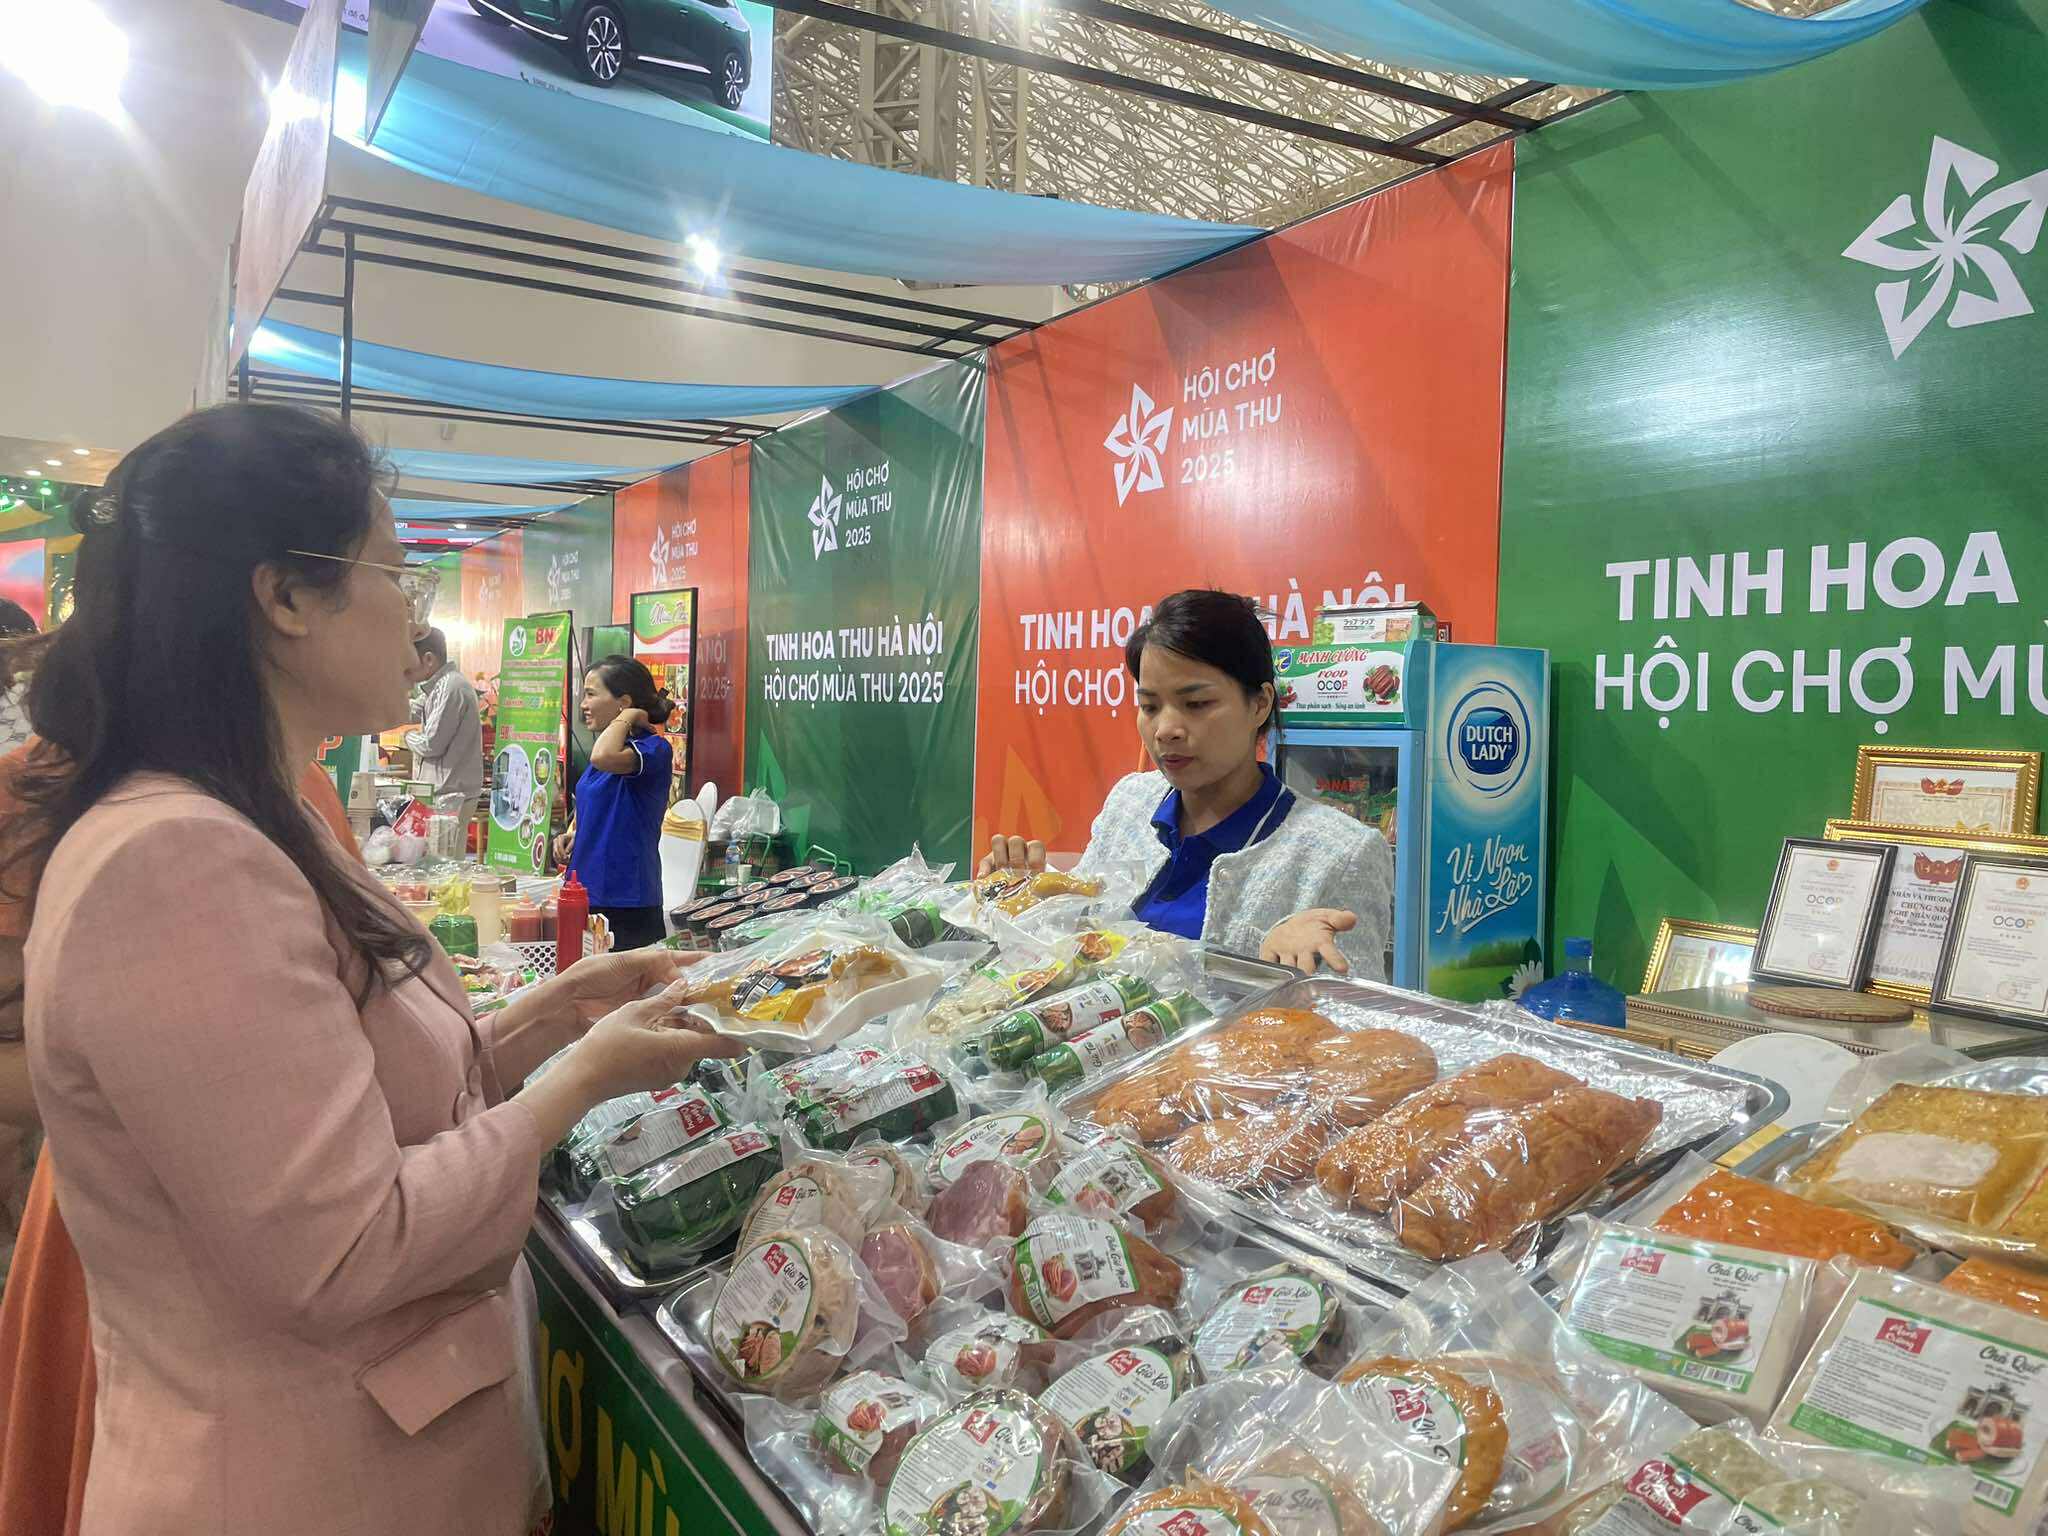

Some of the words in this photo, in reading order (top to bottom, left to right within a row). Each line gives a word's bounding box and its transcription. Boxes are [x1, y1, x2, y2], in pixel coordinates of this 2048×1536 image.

[1183, 366, 1219, 403] HỘI
[1225, 347, 1276, 387] CHỢ
[1182, 407, 1229, 443] MÙA
[1235, 393, 1282, 431] THU
[846, 468, 864, 493] HỘI
[866, 460, 889, 487] CHỢ
[1181, 449, 1234, 484] 2025
[845, 496, 868, 521] MÙA
[871, 491, 892, 514] THU
[845, 525, 871, 547] 2025
[1606, 548, 1784, 621] TINH
[1809, 531, 2019, 614] HOA
[766, 633, 798, 661] TINH
[801, 630, 835, 660] HOA
[839, 627, 873, 658] THU
[877, 615, 903, 657] HÀ
[908, 612, 943, 665] NỘI
[1020, 610, 1083, 650] TINH
[764, 667, 786, 708] HỘI
[788, 670, 820, 709] CHỢ
[822, 665, 857, 702] MÙA
[861, 673, 894, 703] THU
[898, 671, 944, 704] 2025
[1015, 659, 1057, 716] HỘI
[1064, 662, 1125, 718] CHỢ
[1317, 670, 1348, 678] FOOD
[1317, 680, 1347, 691] OCOP
[1595, 634, 1709, 729] HỘI
[1731, 636, 1914, 735] CHỢ
[1466, 725, 1512, 743] DUTCH
[1472, 743, 1507, 760] LADY
[1473, 834, 1529, 886] Ngon
[1436, 884, 1484, 935] Nhà
